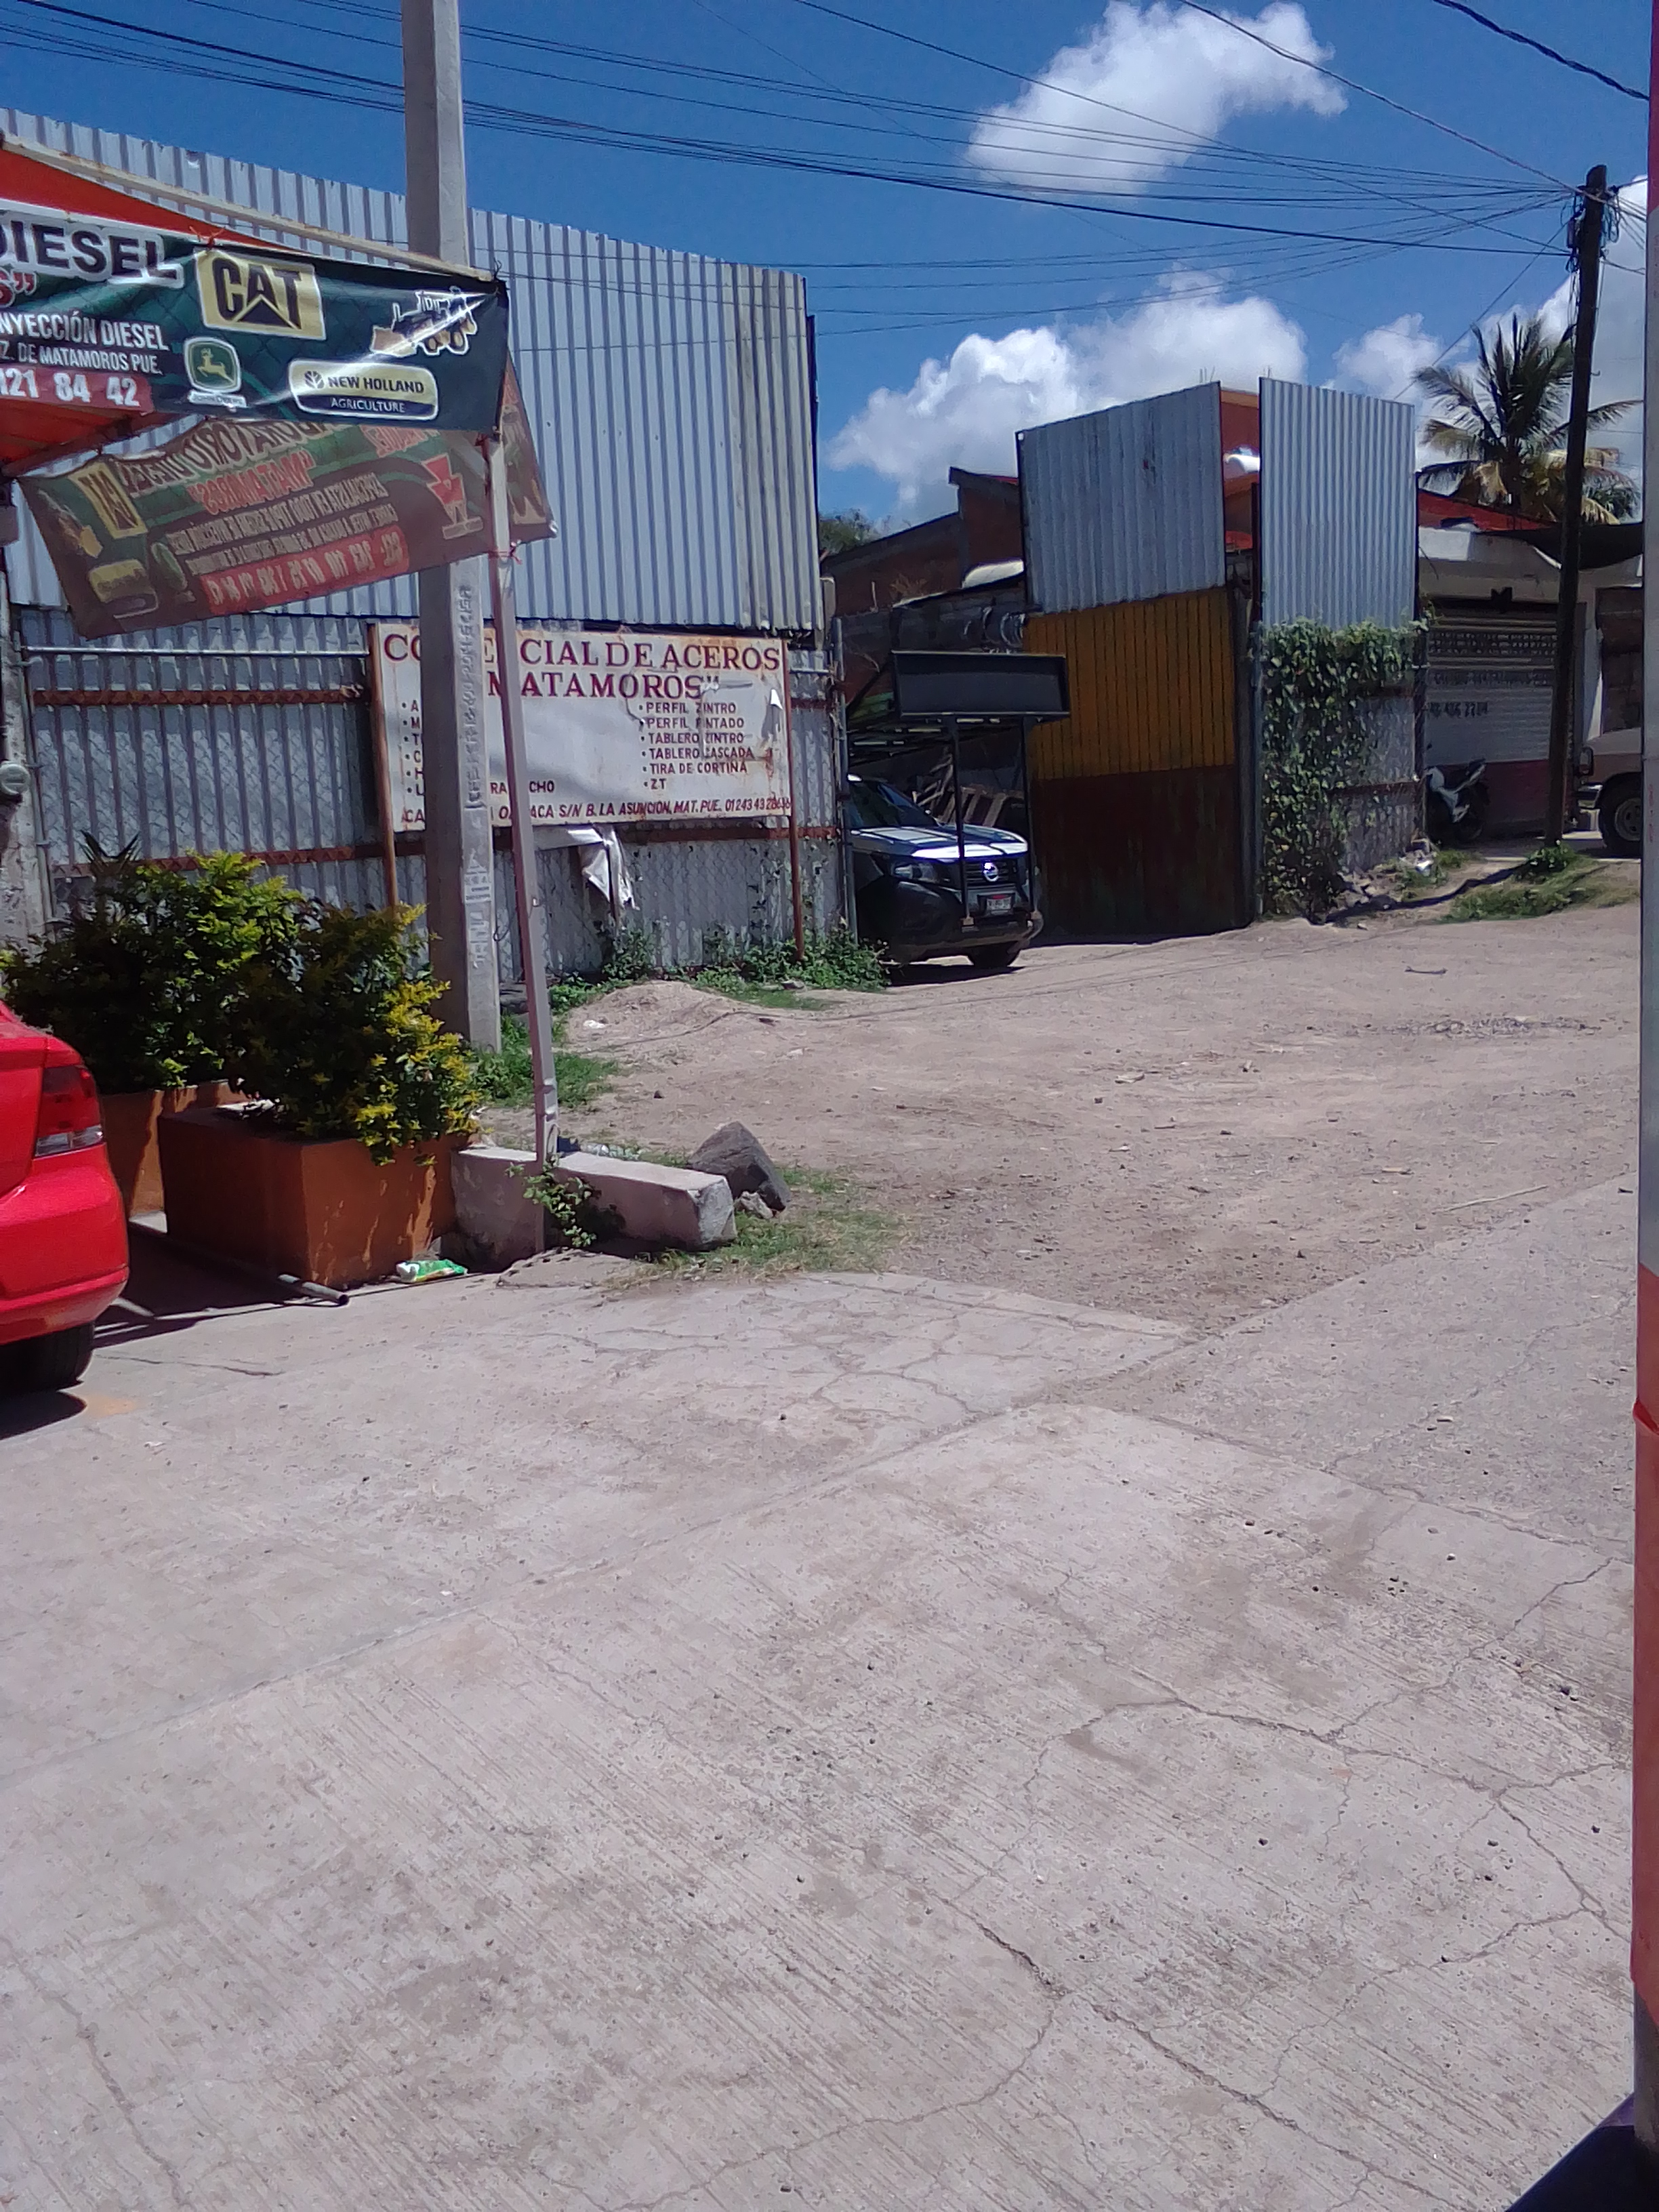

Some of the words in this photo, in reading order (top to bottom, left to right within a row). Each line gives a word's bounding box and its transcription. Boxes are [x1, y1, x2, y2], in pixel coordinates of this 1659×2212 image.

[212, 257, 302, 329] CAT
[100, 321, 169, 351] DIESEL
[18, 342, 38, 364] DE
[39, 346, 130, 371] MATAMOROS
[131, 354, 163, 375] PUE.
[53, 372, 91, 403] 84
[106, 376, 140, 407] 42
[328, 376, 359, 389] NEW
[363, 377, 425, 394] HOLLAND
[331, 398, 405, 413] AGRICULTURE
[605, 641, 653, 668] DE
[660, 643, 780, 670] ACEROS
[646, 702, 688, 715] PERFIL
[695, 702, 736, 715] ZINTRO
[647, 717, 689, 729] PERFIL
[649, 733, 699, 744] TABLERO
[649, 747, 700, 759] TABLERO
[649, 763, 676, 774] TIRA
[679, 762, 694, 774] DE
[697, 761, 748, 774] CORTINA
[559, 803, 582, 818] S/N
